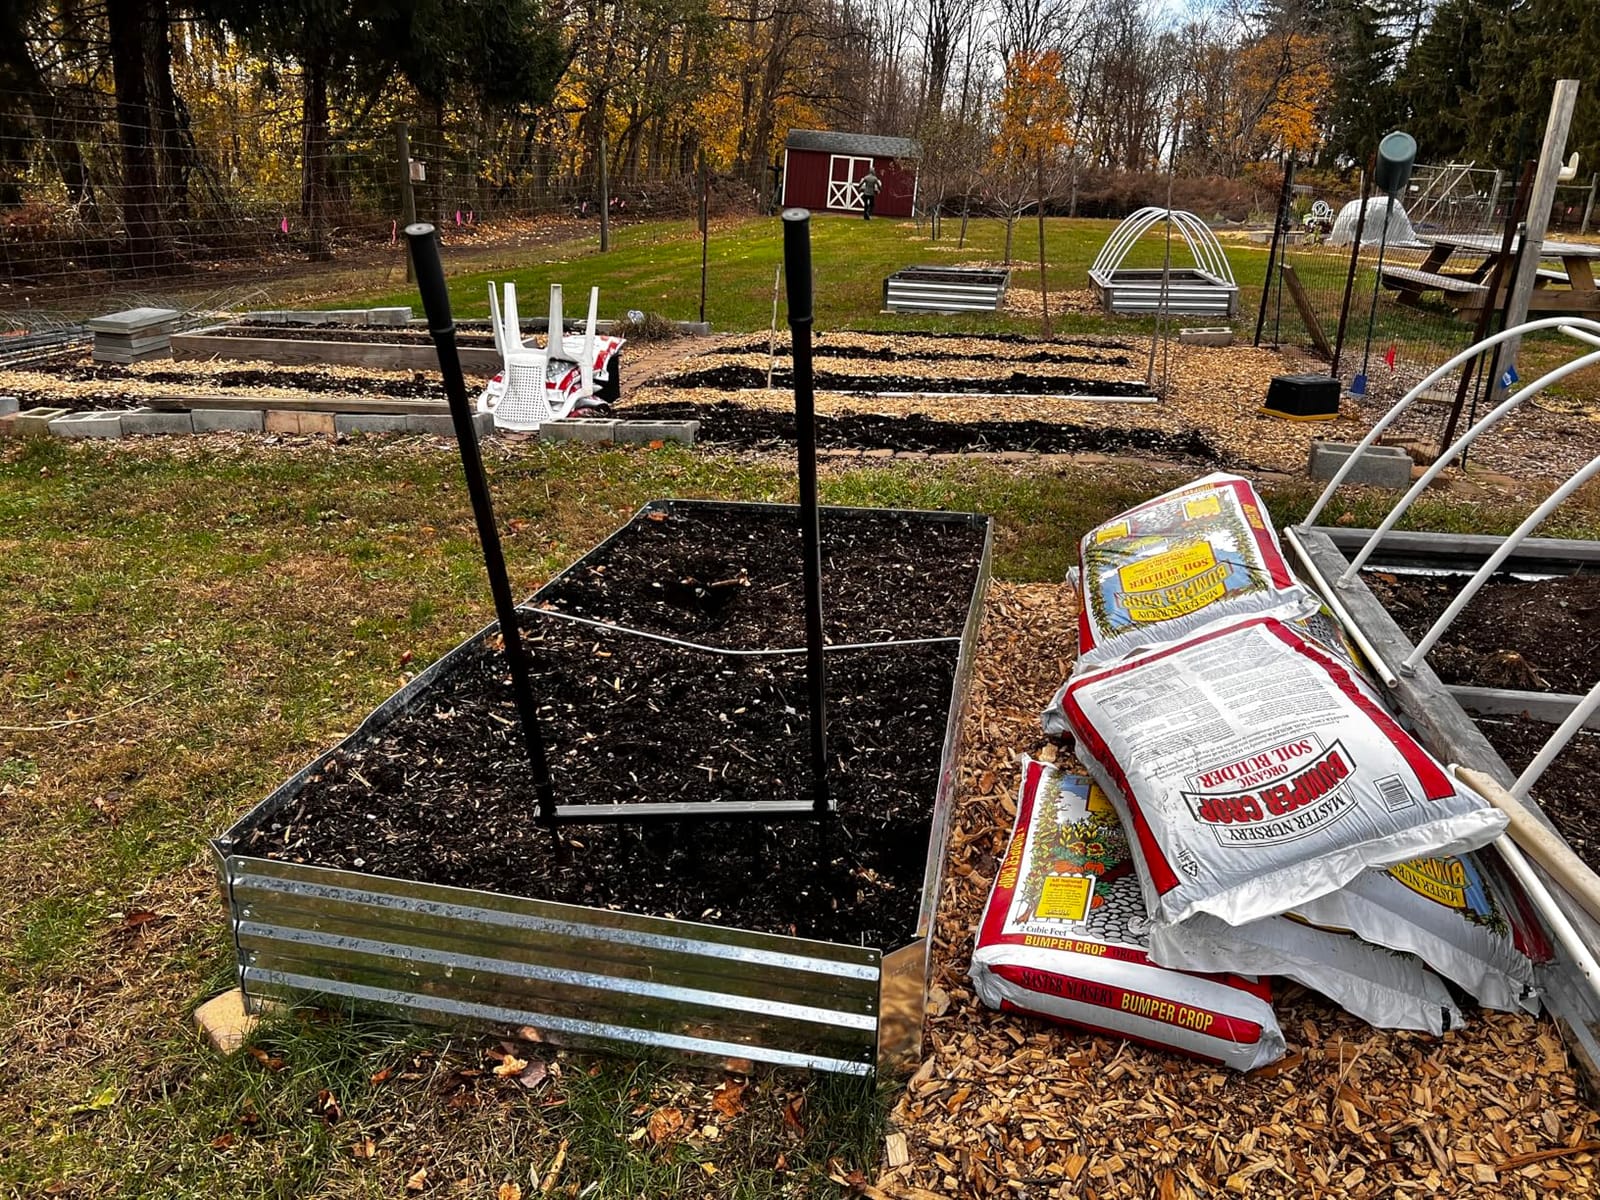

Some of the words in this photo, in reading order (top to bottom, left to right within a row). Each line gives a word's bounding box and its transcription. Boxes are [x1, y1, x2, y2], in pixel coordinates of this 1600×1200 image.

[1183, 558, 1209, 572] SOIL
[1128, 567, 1179, 590] BUILDER
[1164, 563, 1228, 605] BUMPER
[1121, 591, 1163, 609] CROP
[1271, 738, 1313, 763] SOIL
[1199, 755, 1273, 789] BUILDER
[1237, 763, 1289, 789] ORGANIC
[1258, 750, 1350, 817] BUMPER
[1197, 794, 1265, 825] CROP
[1295, 791, 1347, 829] MASTER
[1229, 818, 1296, 842] NURSERY
[997, 867, 1018, 889] CROP
[1423, 880, 1460, 904] MASTER
[1019, 924, 1025, 932] 2
[1026, 925, 1049, 936] Cubic
[1049, 927, 1068, 938] Feet
[1024, 934, 1073, 951] BUMPER
[1075, 942, 1107, 956] CROP
[1021, 969, 1064, 993] MASTER
[1065, 977, 1115, 1005] NURSERY
[1121, 992, 1176, 1022] BUMPER
[1177, 1007, 1214, 1032] CROP
